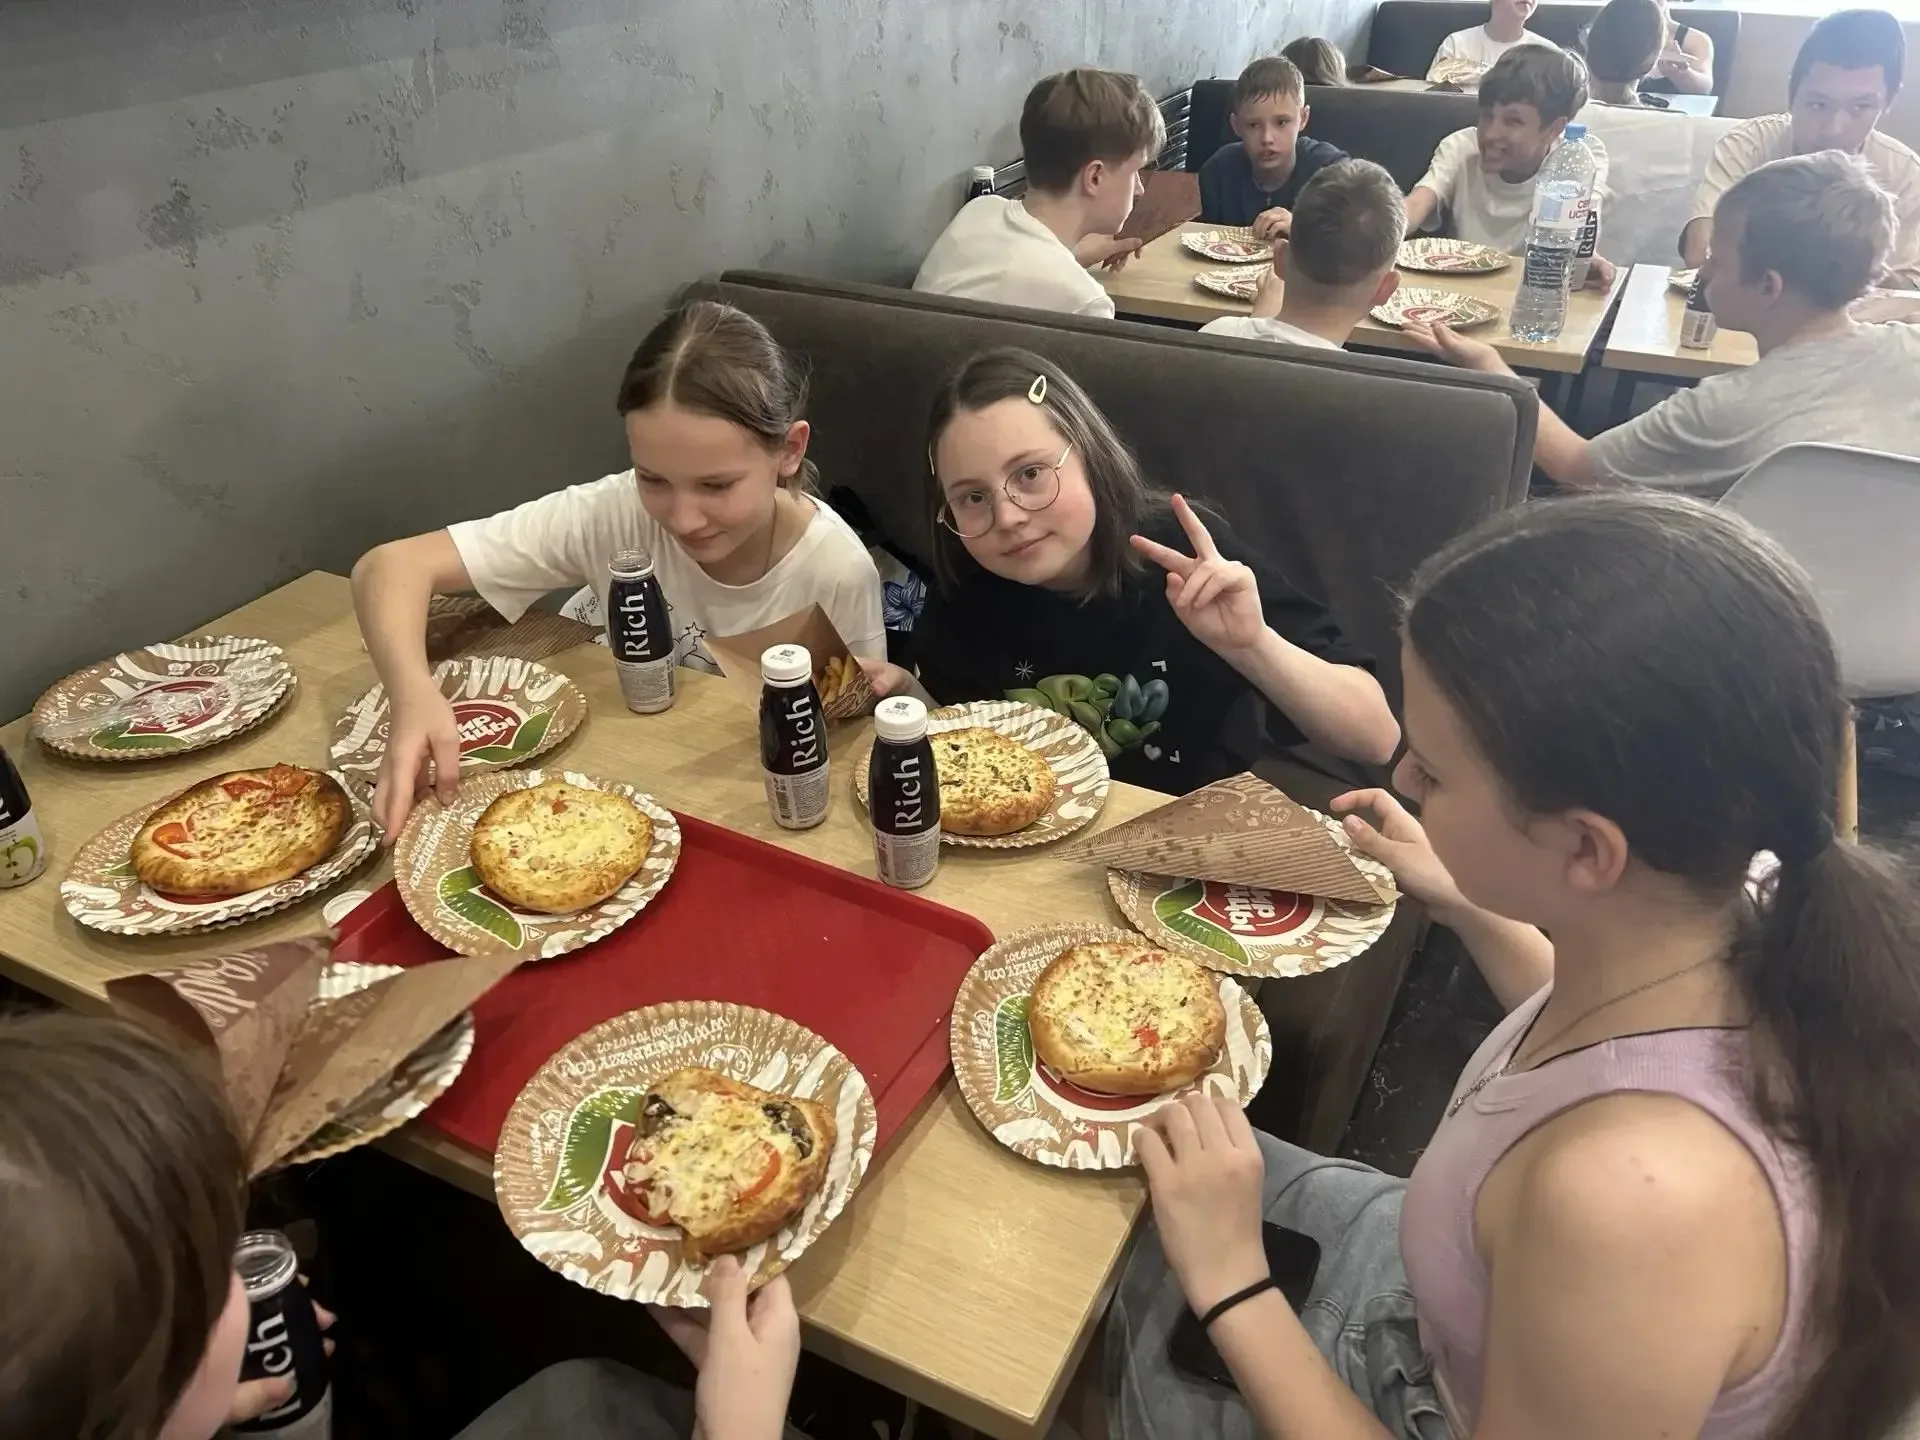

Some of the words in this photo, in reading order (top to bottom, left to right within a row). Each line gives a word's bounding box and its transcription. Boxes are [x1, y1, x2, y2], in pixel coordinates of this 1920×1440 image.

[619, 593, 651, 657] Rich
[457, 714, 492, 733] ИР
[458, 716, 518, 744] ЦЦЫ
[785, 695, 820, 769] Rich
[892, 755, 923, 829] Rich
[1223, 884, 1257, 932] ЦЦЫ
[1249, 887, 1276, 918] ИР
